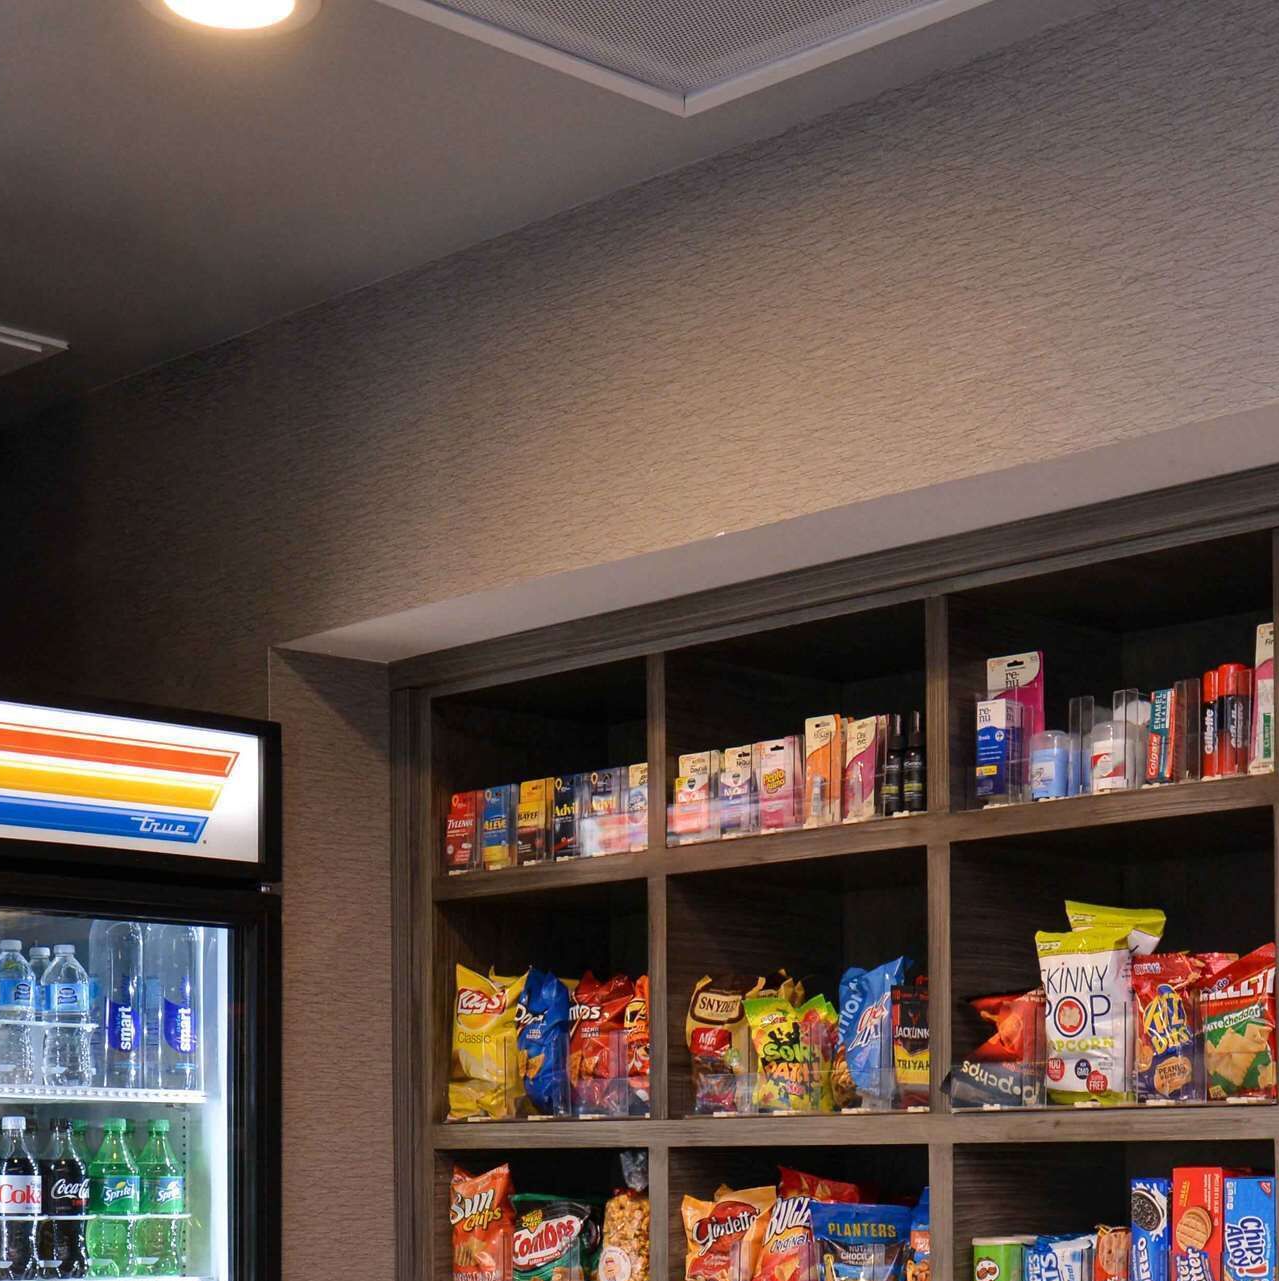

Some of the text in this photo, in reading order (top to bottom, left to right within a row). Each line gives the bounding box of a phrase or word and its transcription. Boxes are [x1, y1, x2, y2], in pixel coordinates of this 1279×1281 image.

[1154, 692, 1163, 730] ENAMEL
[1203, 708, 1214, 755] Gillette
[1148, 735, 1161, 776] Colgate
[130, 815, 191, 836] true
[553, 802, 578, 817] Advil
[118, 1006, 132, 1051] smart
[178, 1007, 192, 1052] smart
[450, 1189, 494, 1224] Sun
[463, 1206, 502, 1232] Chips
[513, 1219, 576, 1260] Combos
[827, 1222, 897, 1238] PLANTERS
[1239, 1217, 1264, 1265] Chips
